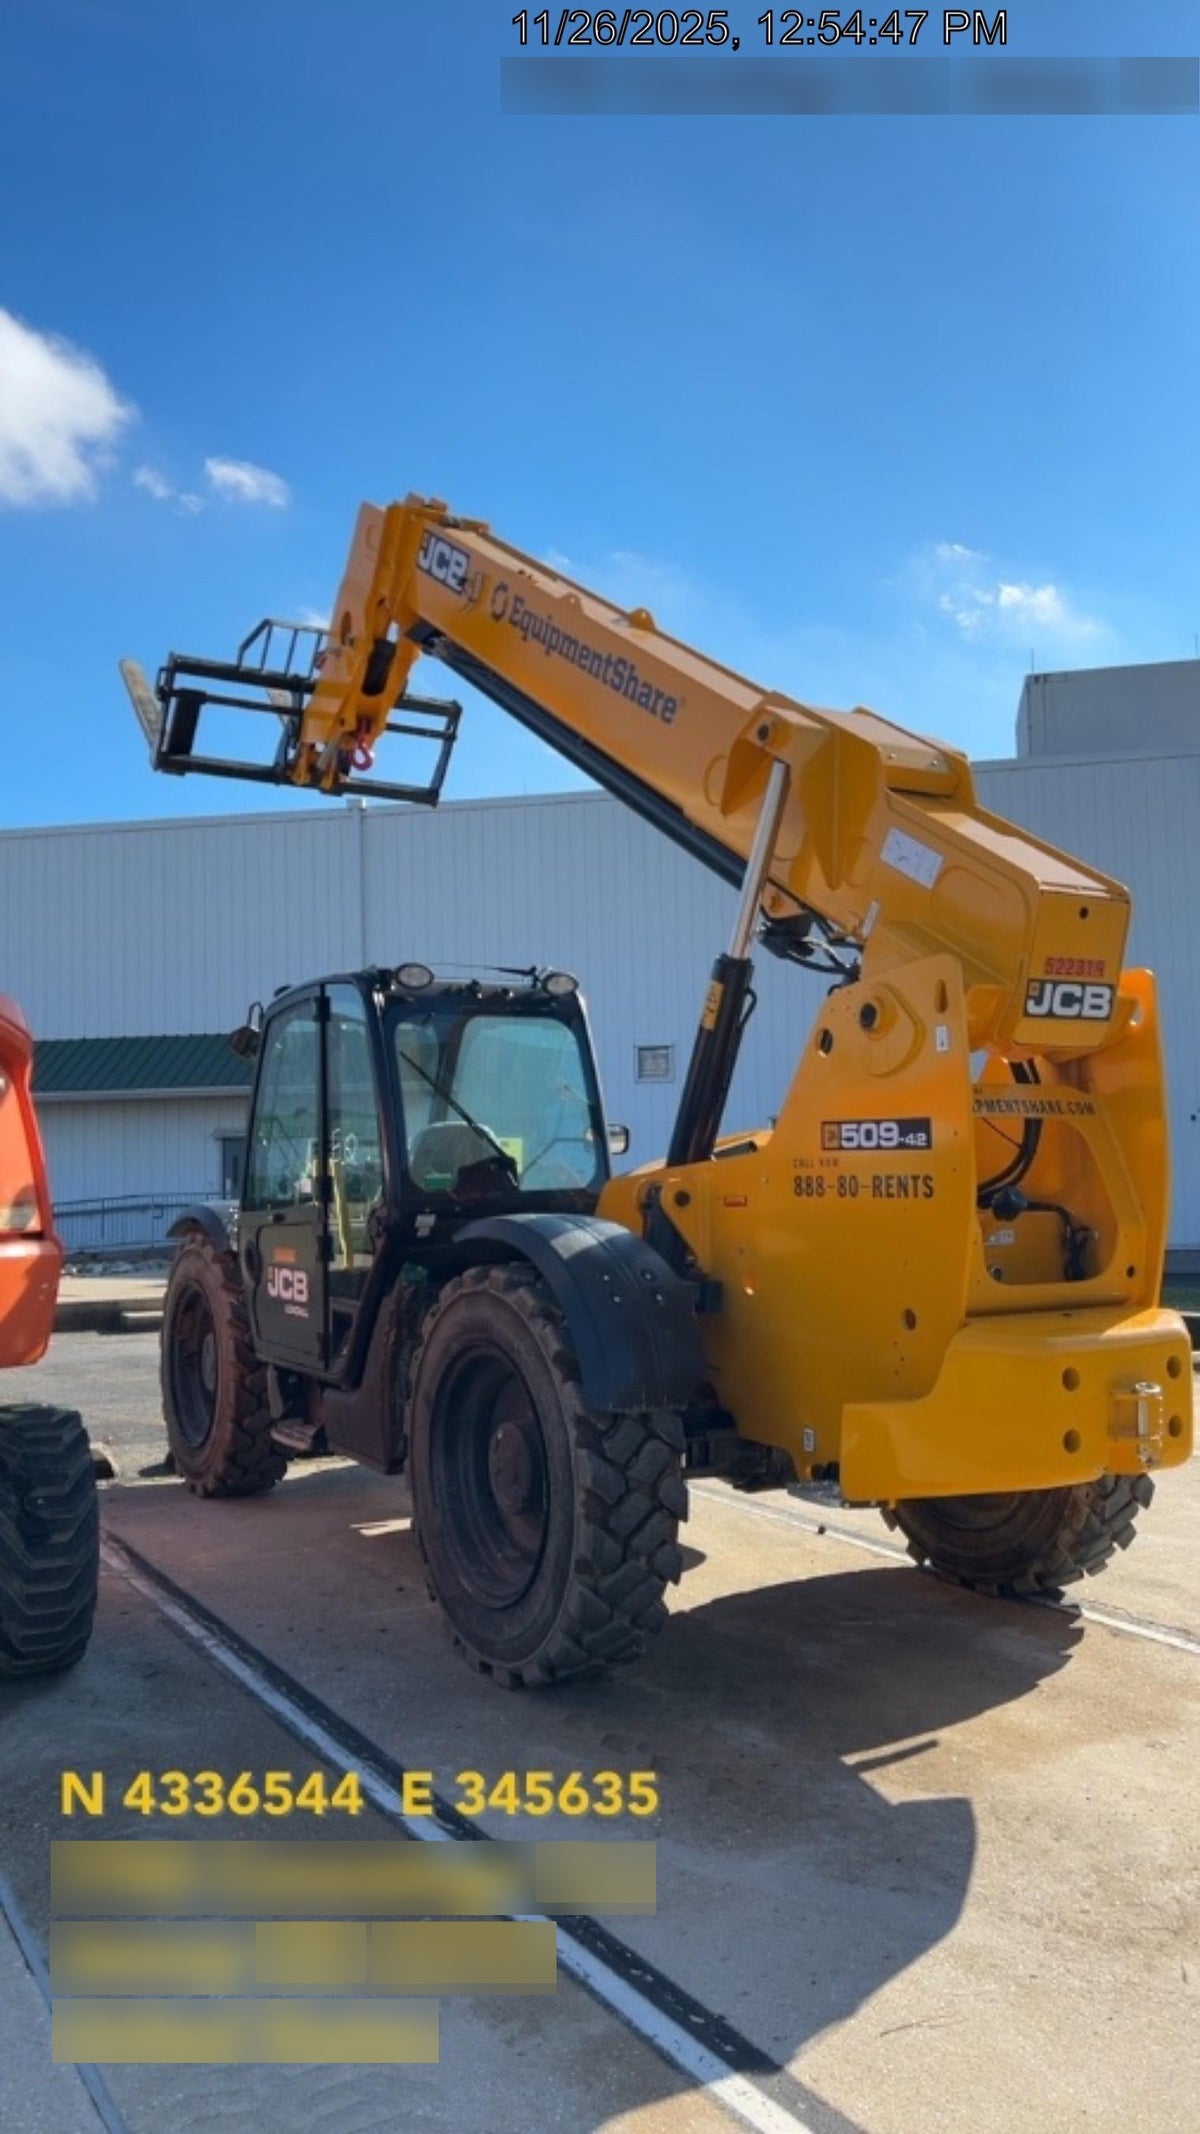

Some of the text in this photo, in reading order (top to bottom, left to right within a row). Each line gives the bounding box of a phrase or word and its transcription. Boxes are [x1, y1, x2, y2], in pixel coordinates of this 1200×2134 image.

[418, 535, 467, 592] JCB
[508, 595, 678, 724] EquipmentShare
[1026, 983, 1111, 1018] JCB
[973, 1099, 1097, 1115] PMENTSHARE.COM
[840, 1121, 928, 1149] 509-42
[793, 1175, 934, 1199] 888-80-RENTS
[267, 1267, 308, 1303] JCB
